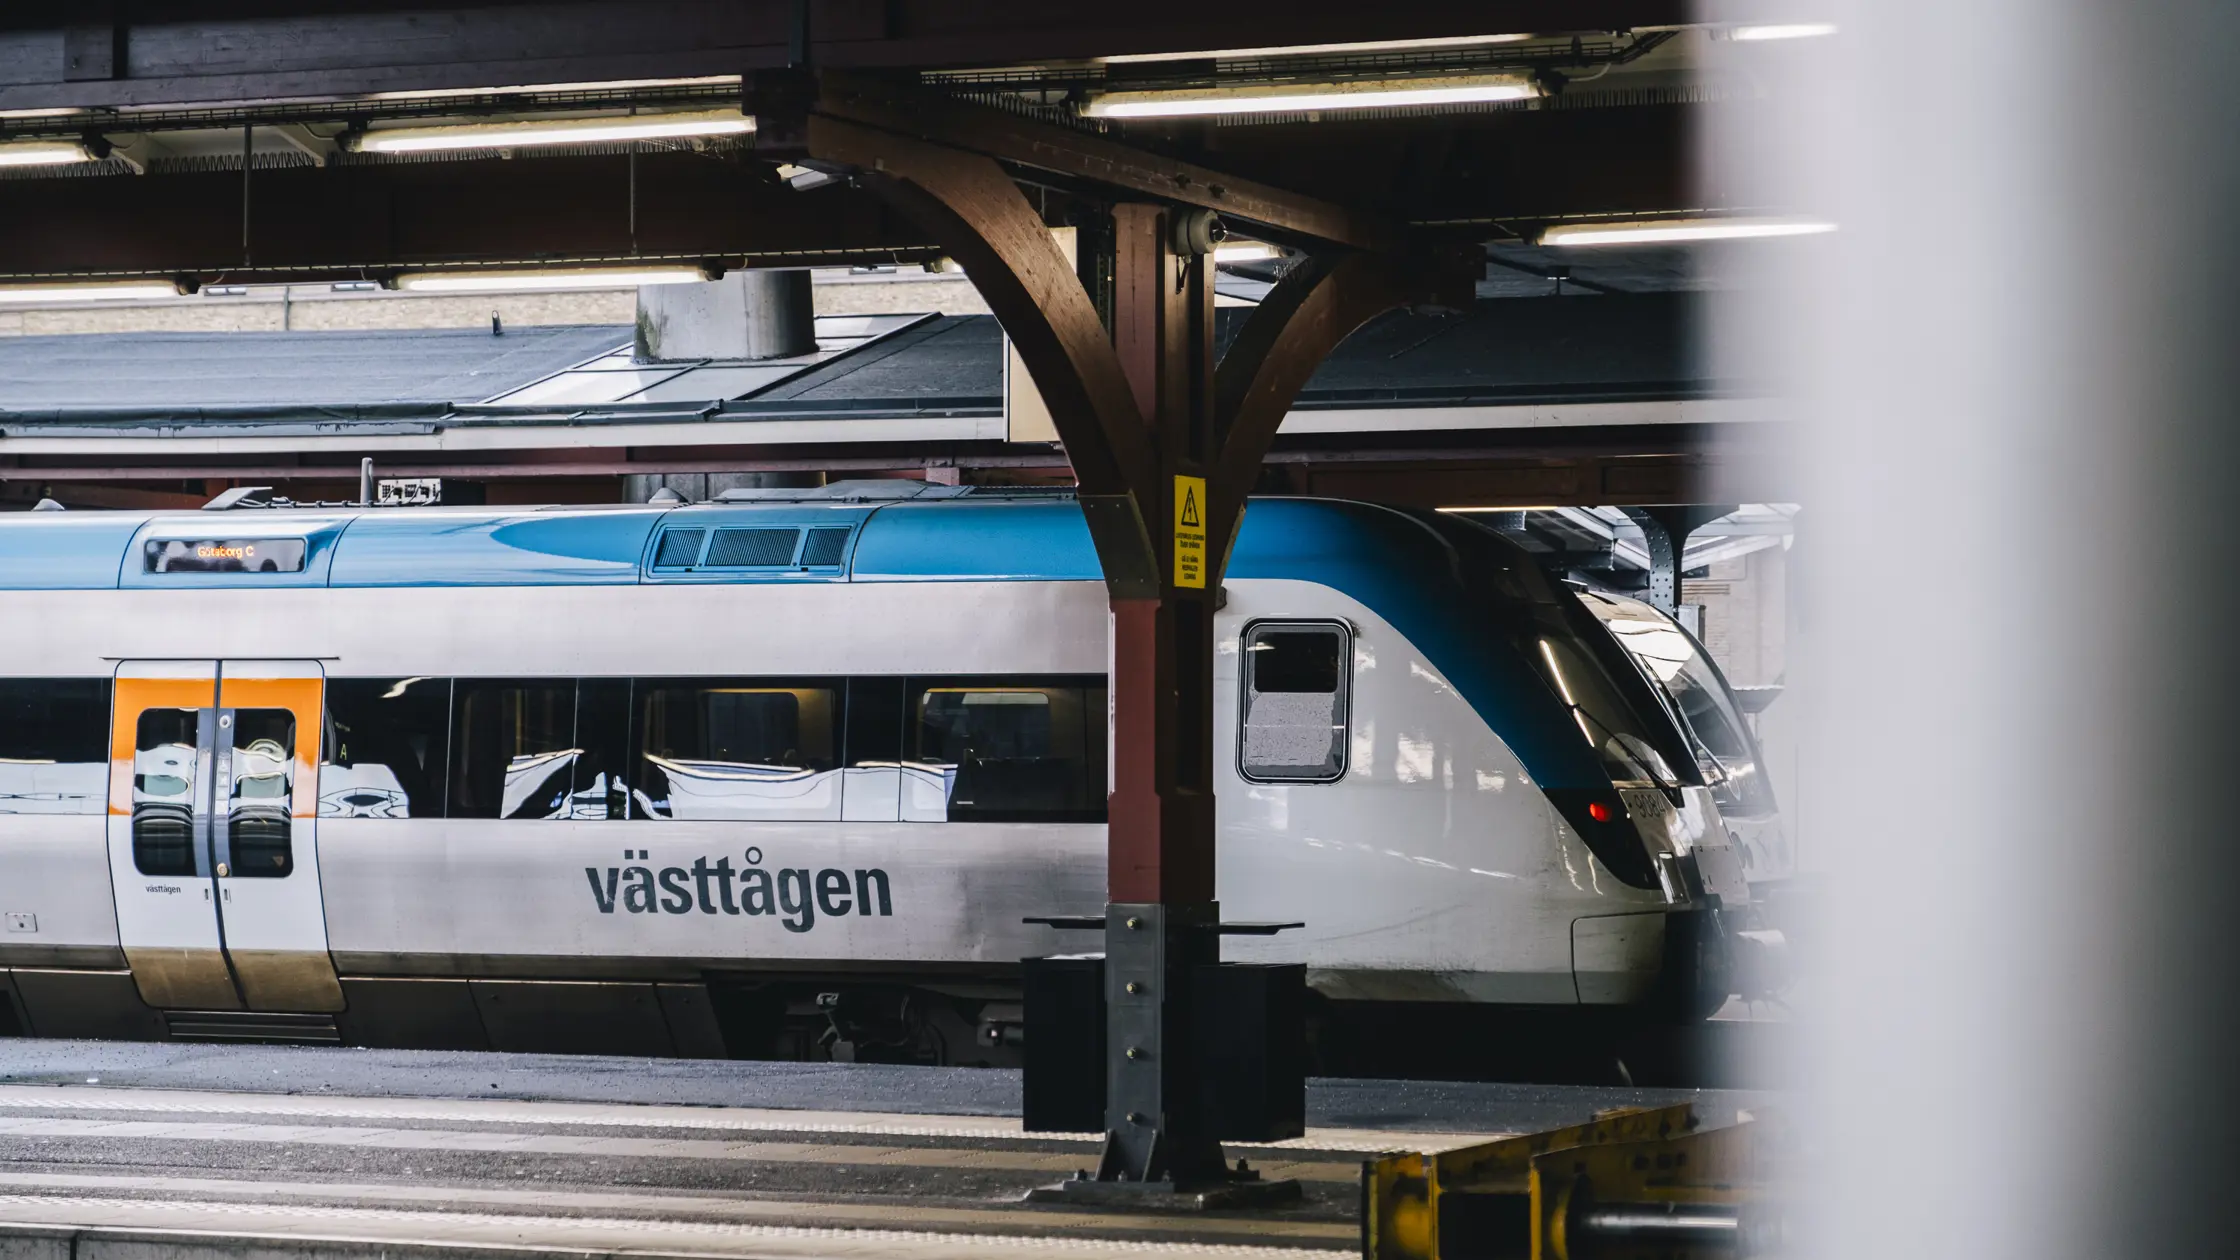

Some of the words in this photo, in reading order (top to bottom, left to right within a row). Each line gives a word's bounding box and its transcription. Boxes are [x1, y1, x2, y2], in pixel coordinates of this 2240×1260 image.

[245, 545, 255, 557] C
[145, 884, 182, 896] västtågen
[585, 846, 893, 933] västtågen
